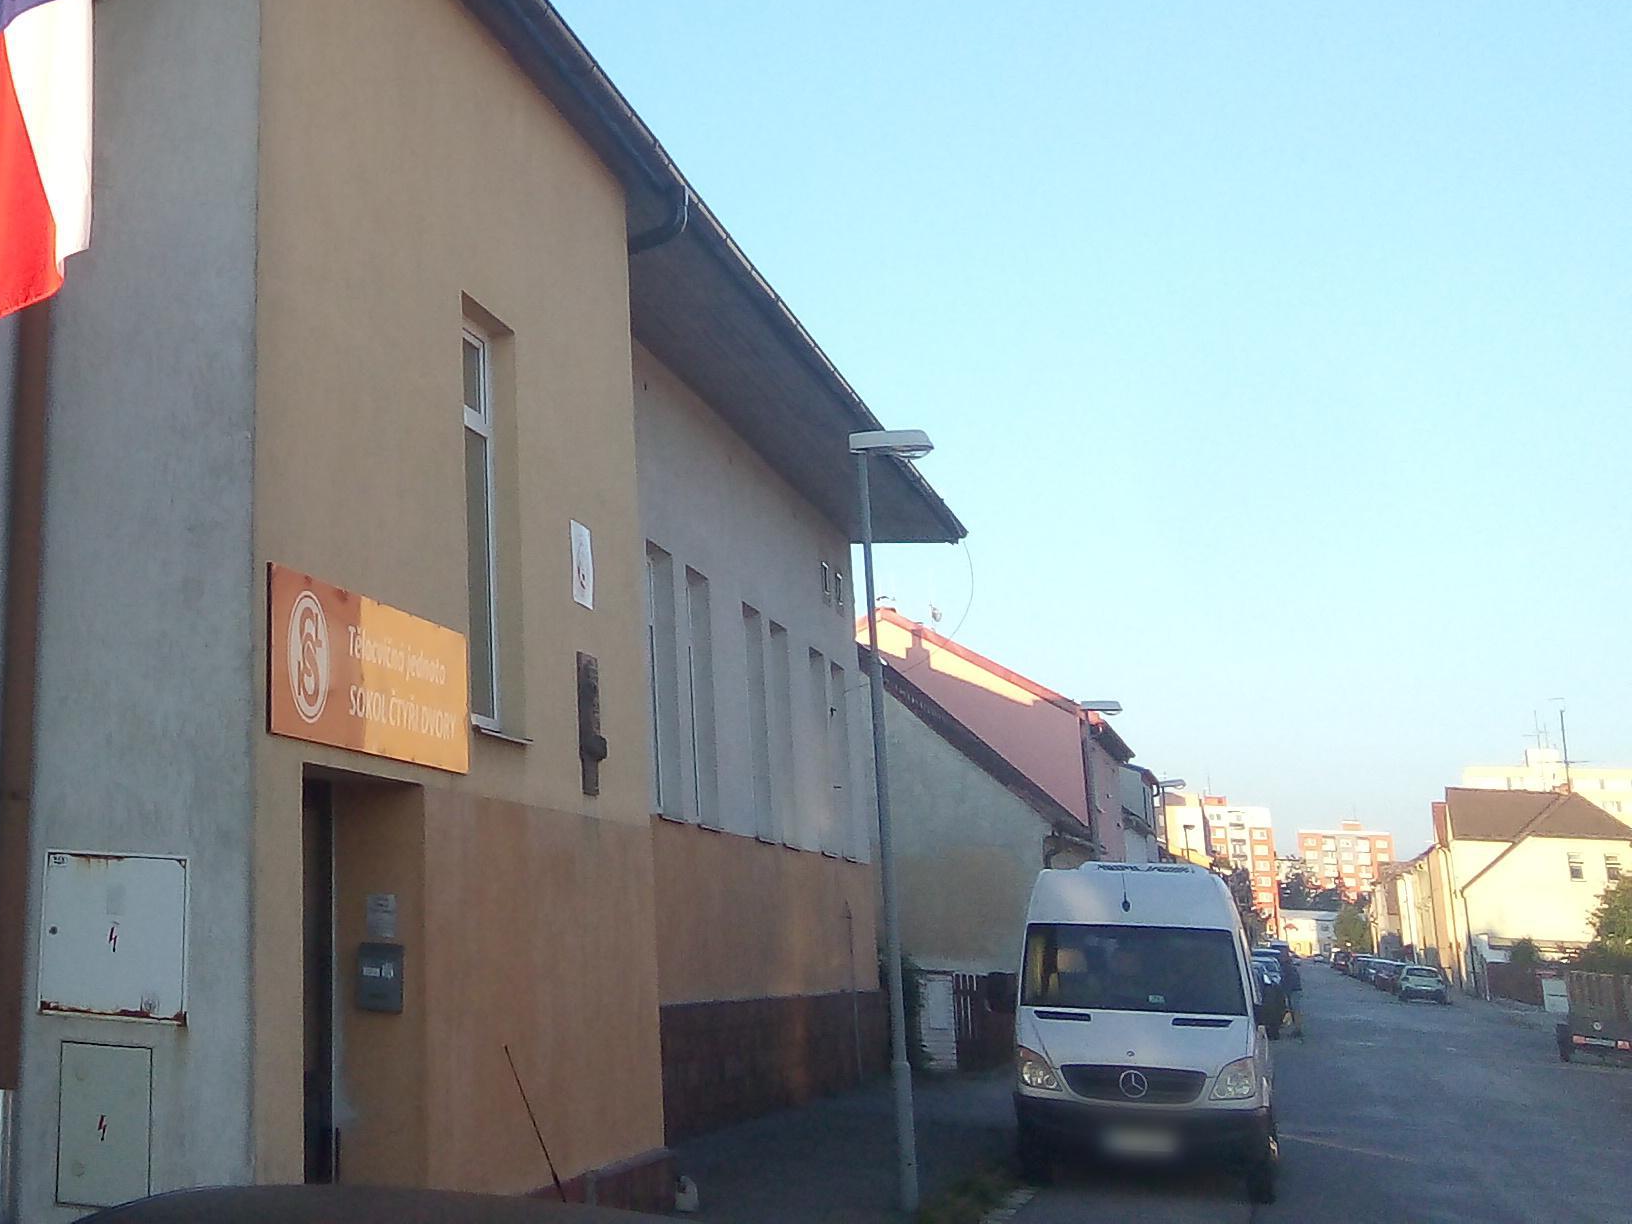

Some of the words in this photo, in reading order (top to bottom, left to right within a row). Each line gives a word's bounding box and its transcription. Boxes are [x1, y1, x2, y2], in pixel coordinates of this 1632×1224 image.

[405, 646, 447, 685] jednota
[349, 684, 387, 724] SOKOL
[421, 705, 457, 741] DVORY
